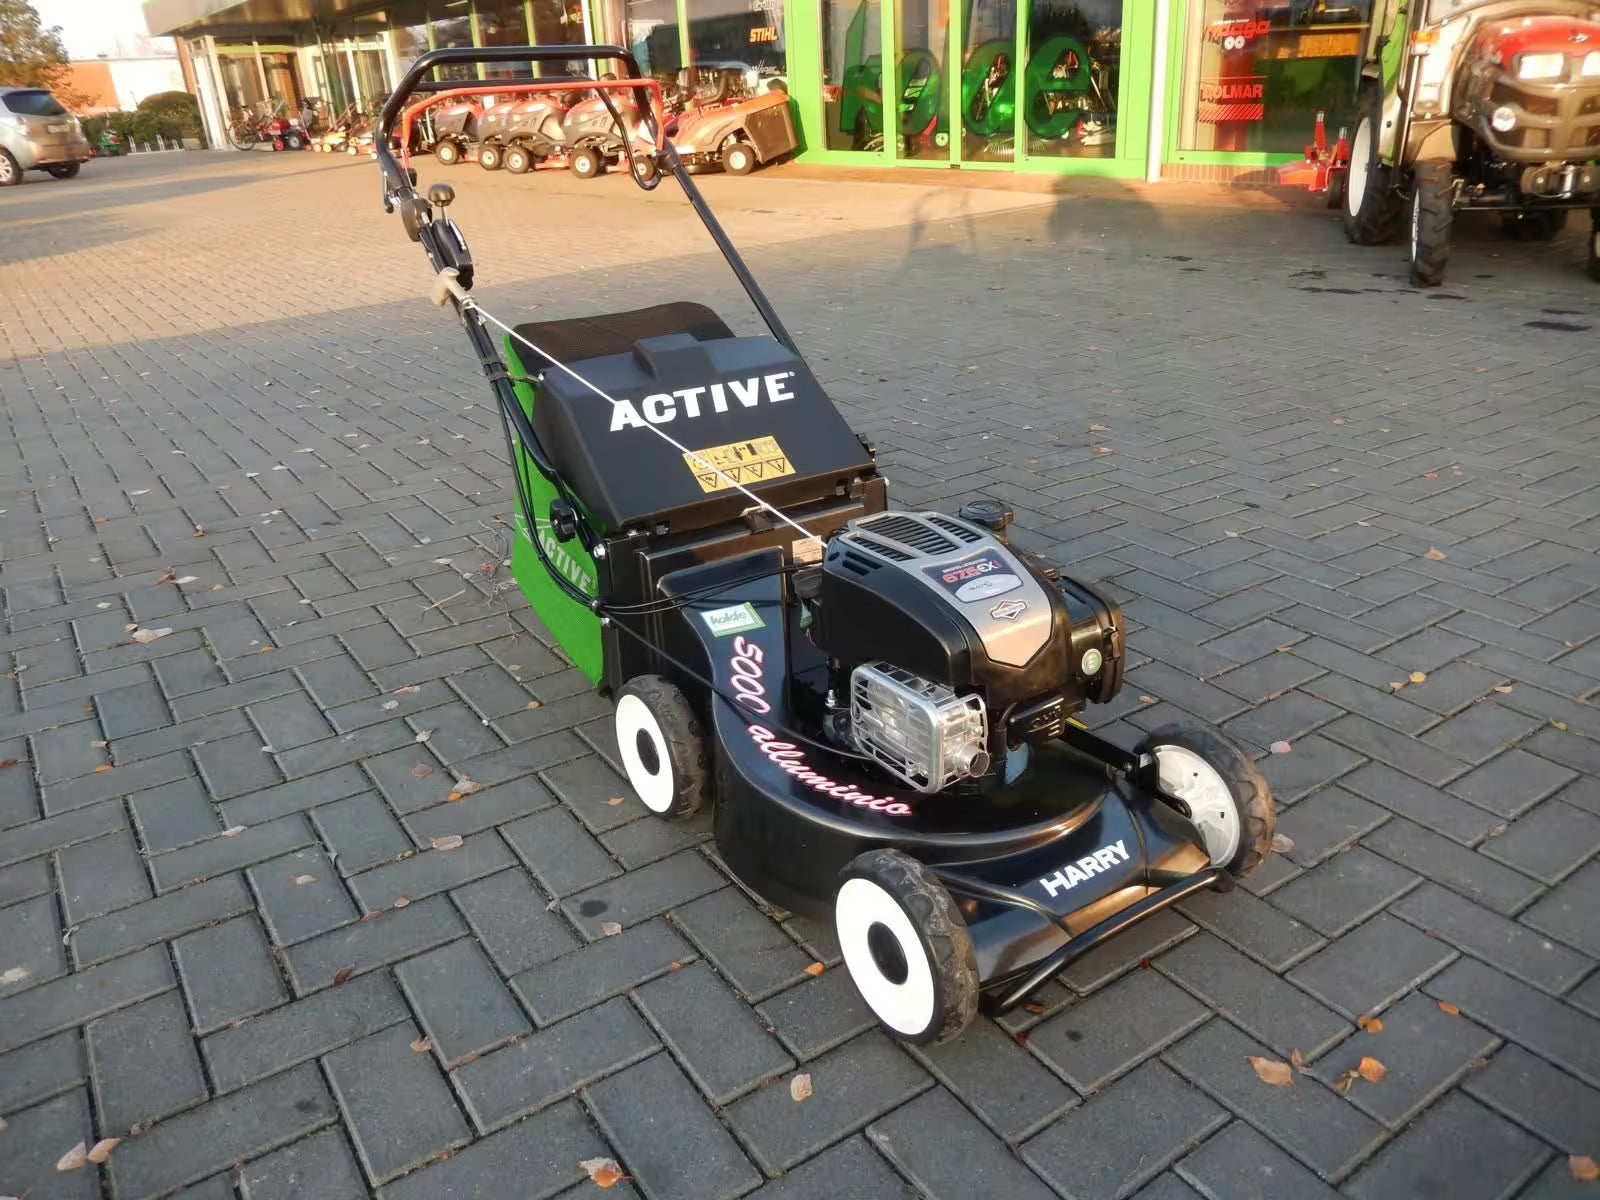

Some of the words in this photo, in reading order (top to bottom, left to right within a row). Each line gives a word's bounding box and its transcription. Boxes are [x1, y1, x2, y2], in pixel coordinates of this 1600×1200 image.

[750, 27, 778, 43] STIHL
[609, 371, 795, 432] ACTIVE
[730, 635, 771, 714] 5000
[748, 724, 913, 816] alluminio
[1039, 839, 1130, 898] HARRY
